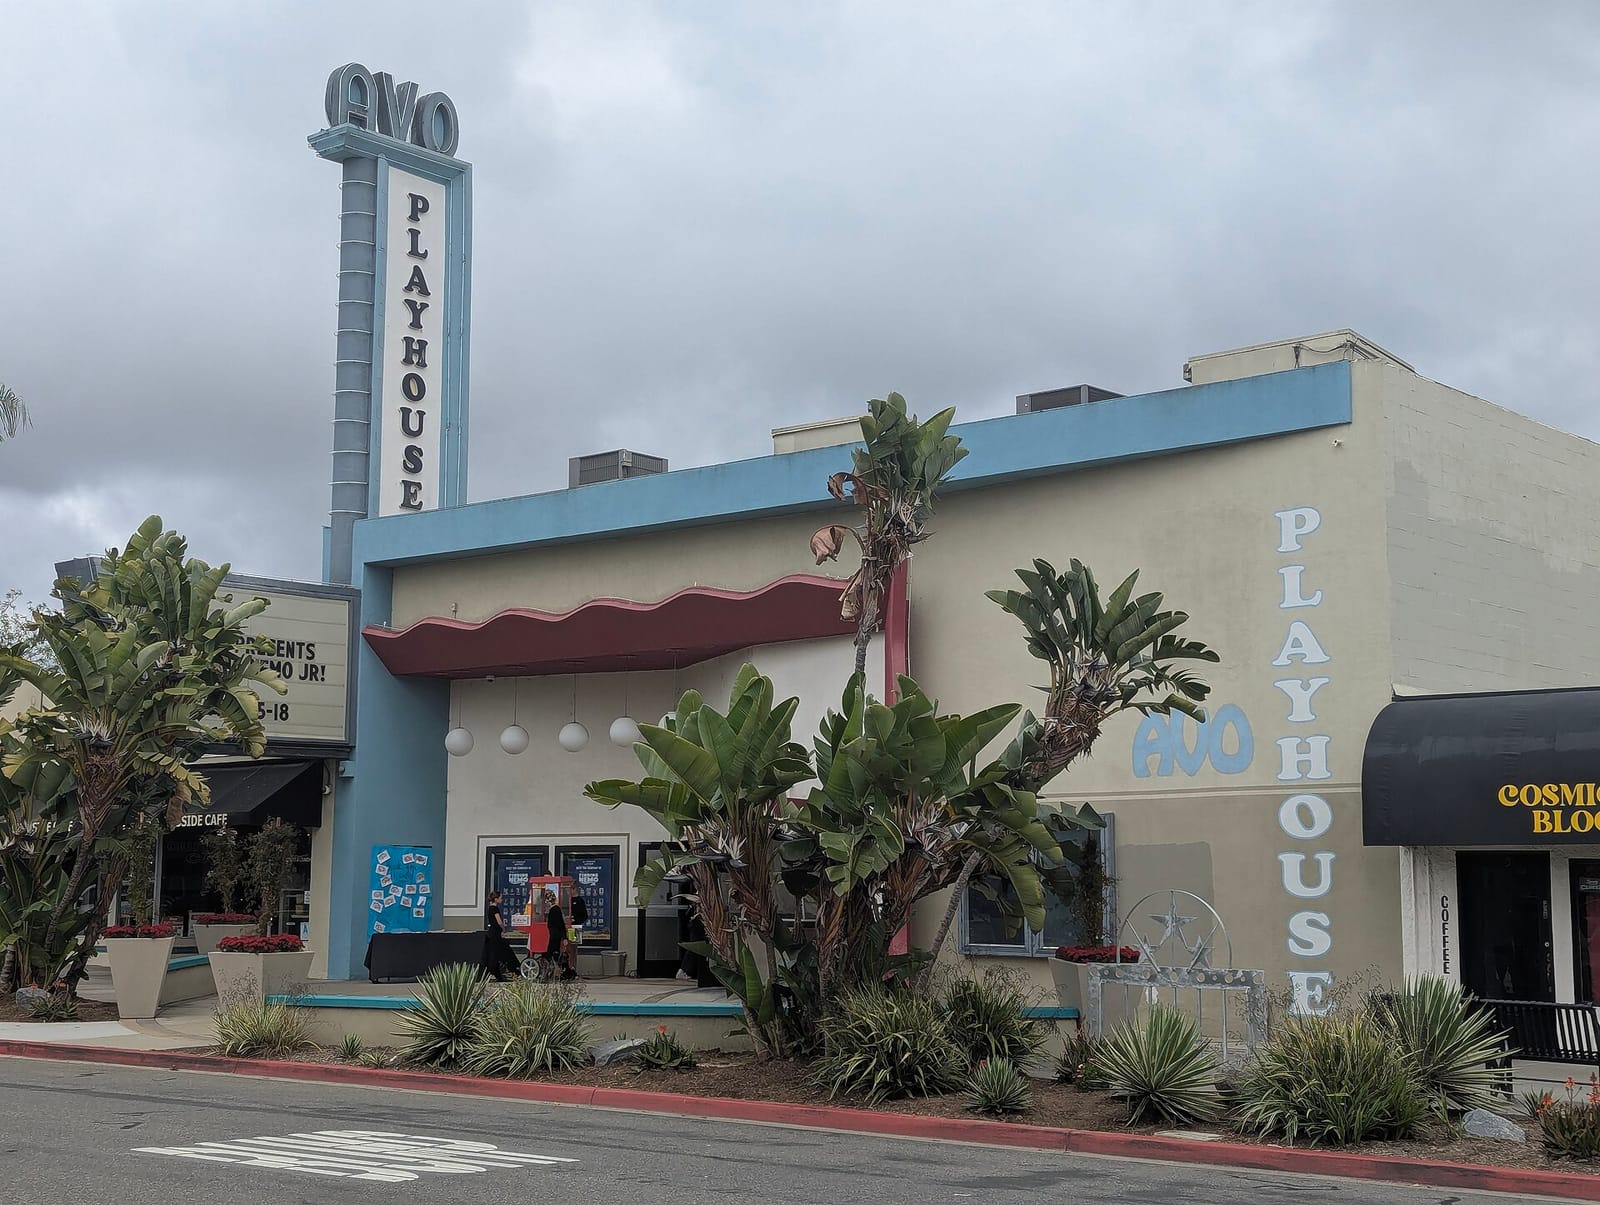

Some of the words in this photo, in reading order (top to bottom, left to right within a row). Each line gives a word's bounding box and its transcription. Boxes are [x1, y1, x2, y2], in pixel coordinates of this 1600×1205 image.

[325, 62, 459, 158] AVO
[399, 192, 431, 511] PLAYHOUSE
[299, 663, 326, 682] JR!
[1132, 703, 1254, 778] AVO
[1272, 506, 1336, 1017] PLAYHOUSE
[176, 814, 203, 827] SIDE
[204, 813, 228, 826] CAFE
[1498, 783, 1600, 807] COSMI
[1532, 809, 1600, 833] BLO
[1441, 895, 1451, 975] COFFEE
[130, 1130, 581, 1183] BUMP
